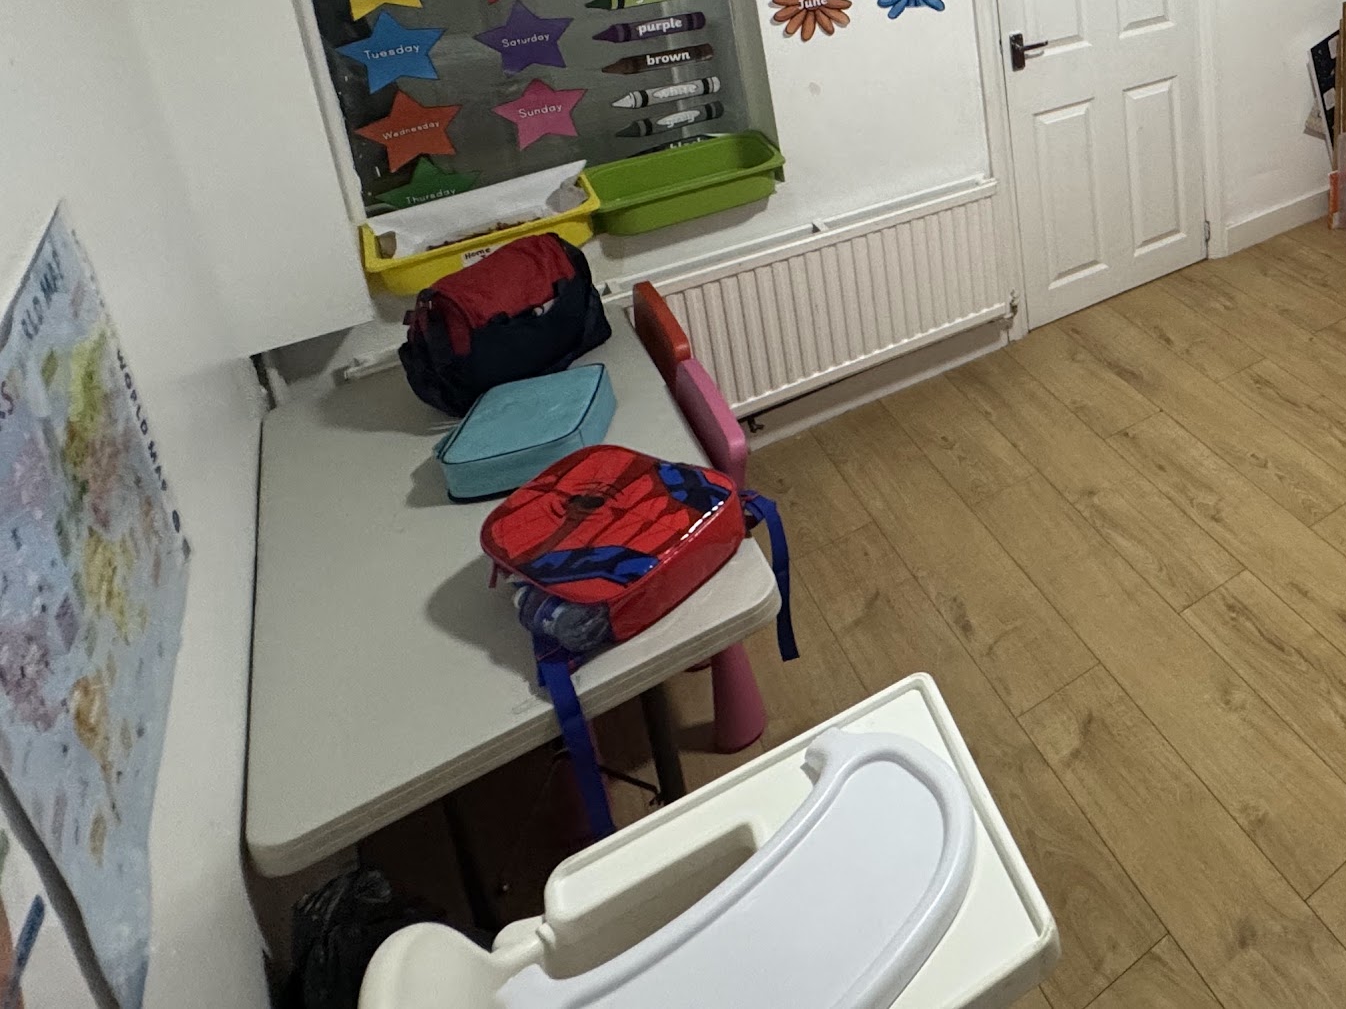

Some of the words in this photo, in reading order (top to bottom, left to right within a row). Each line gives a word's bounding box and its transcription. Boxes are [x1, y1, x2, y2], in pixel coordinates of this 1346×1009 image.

[637, 17, 683, 36] purple
[501, 32, 550, 48] Saturday
[364, 43, 421, 60] Tuesday
[646, 50, 691, 65] brown
[518, 102, 563, 118] Sunday
[382, 120, 441, 141] Wednesday
[405, 188, 457, 205] Thursday
[463, 247, 491, 260] Home
